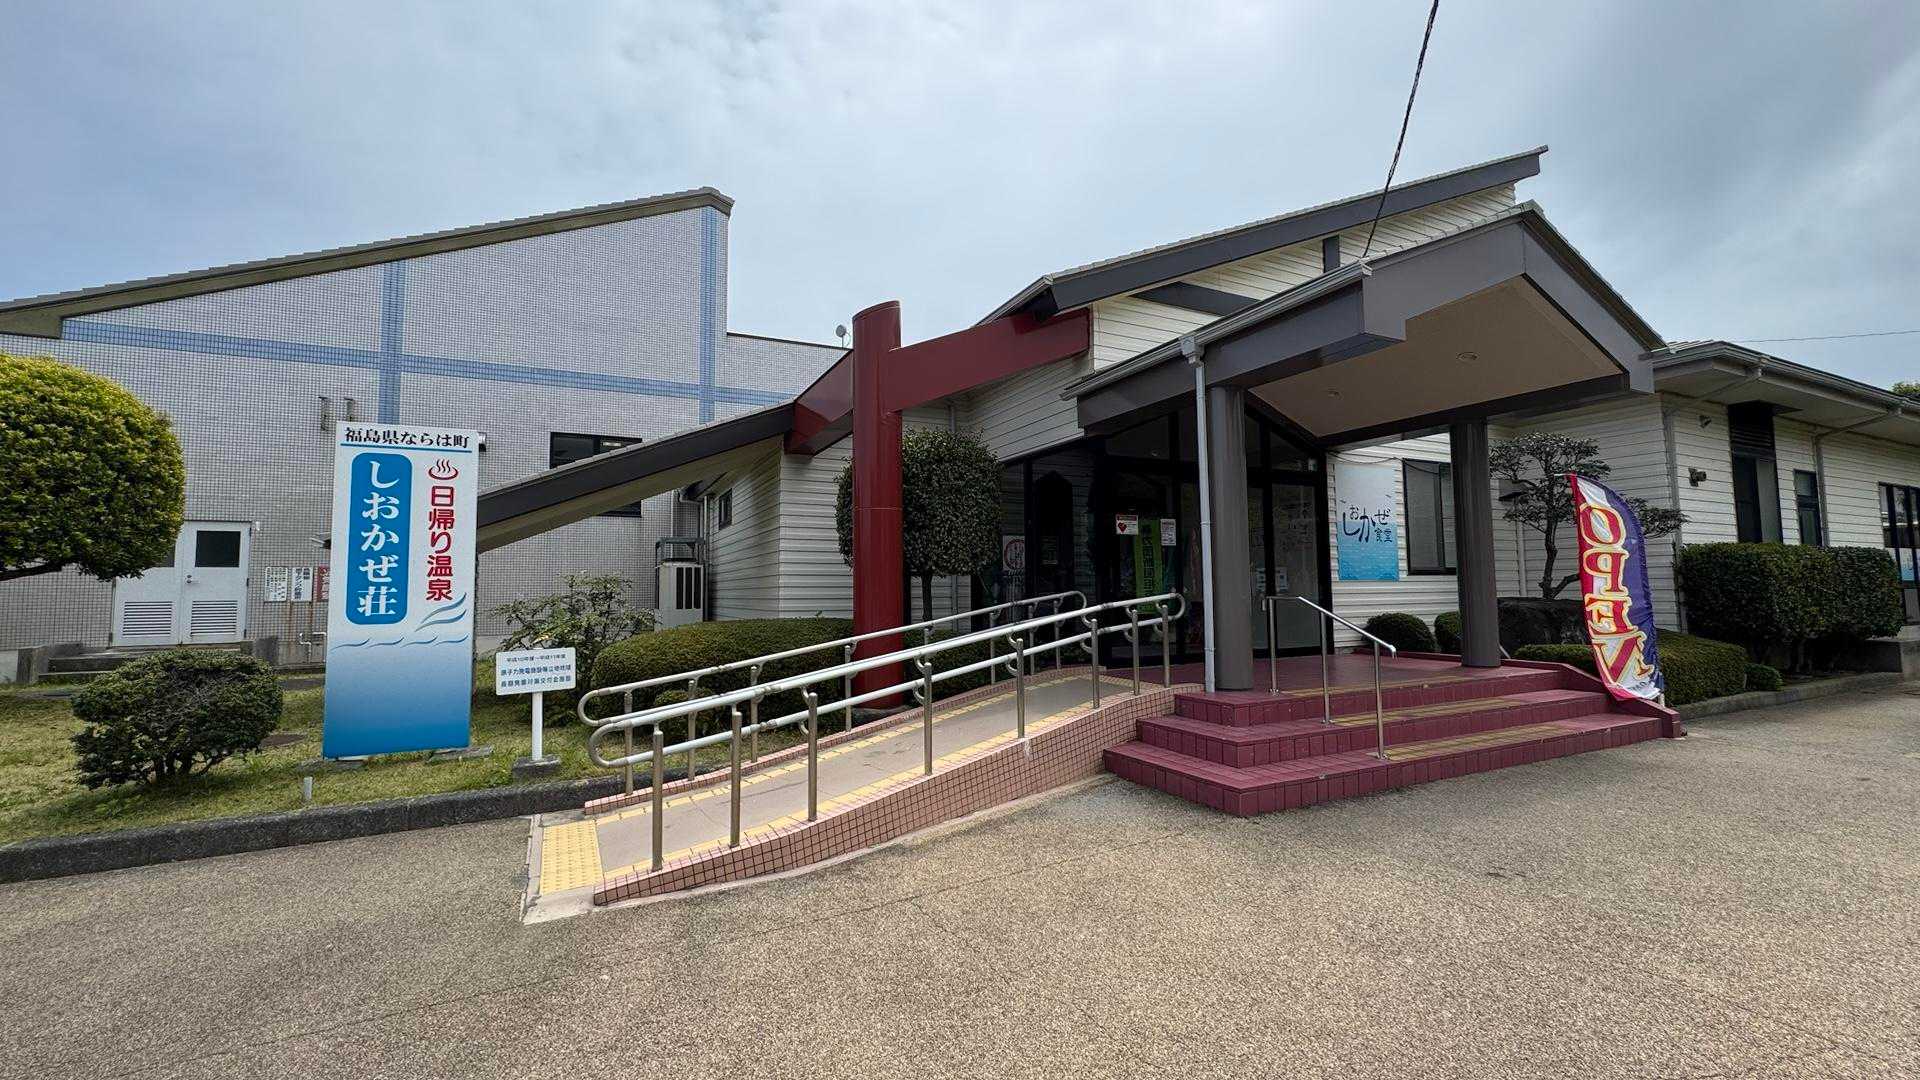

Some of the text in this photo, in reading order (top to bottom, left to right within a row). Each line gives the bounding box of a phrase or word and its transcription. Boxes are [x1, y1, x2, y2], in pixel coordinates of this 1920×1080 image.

[345, 427, 469, 448] 福島県ならは町
[357, 460, 400, 617] しおかぜ荘
[426, 485, 455, 602] 日帰り温泉
[1343, 505, 1391, 543] しおかぜ
